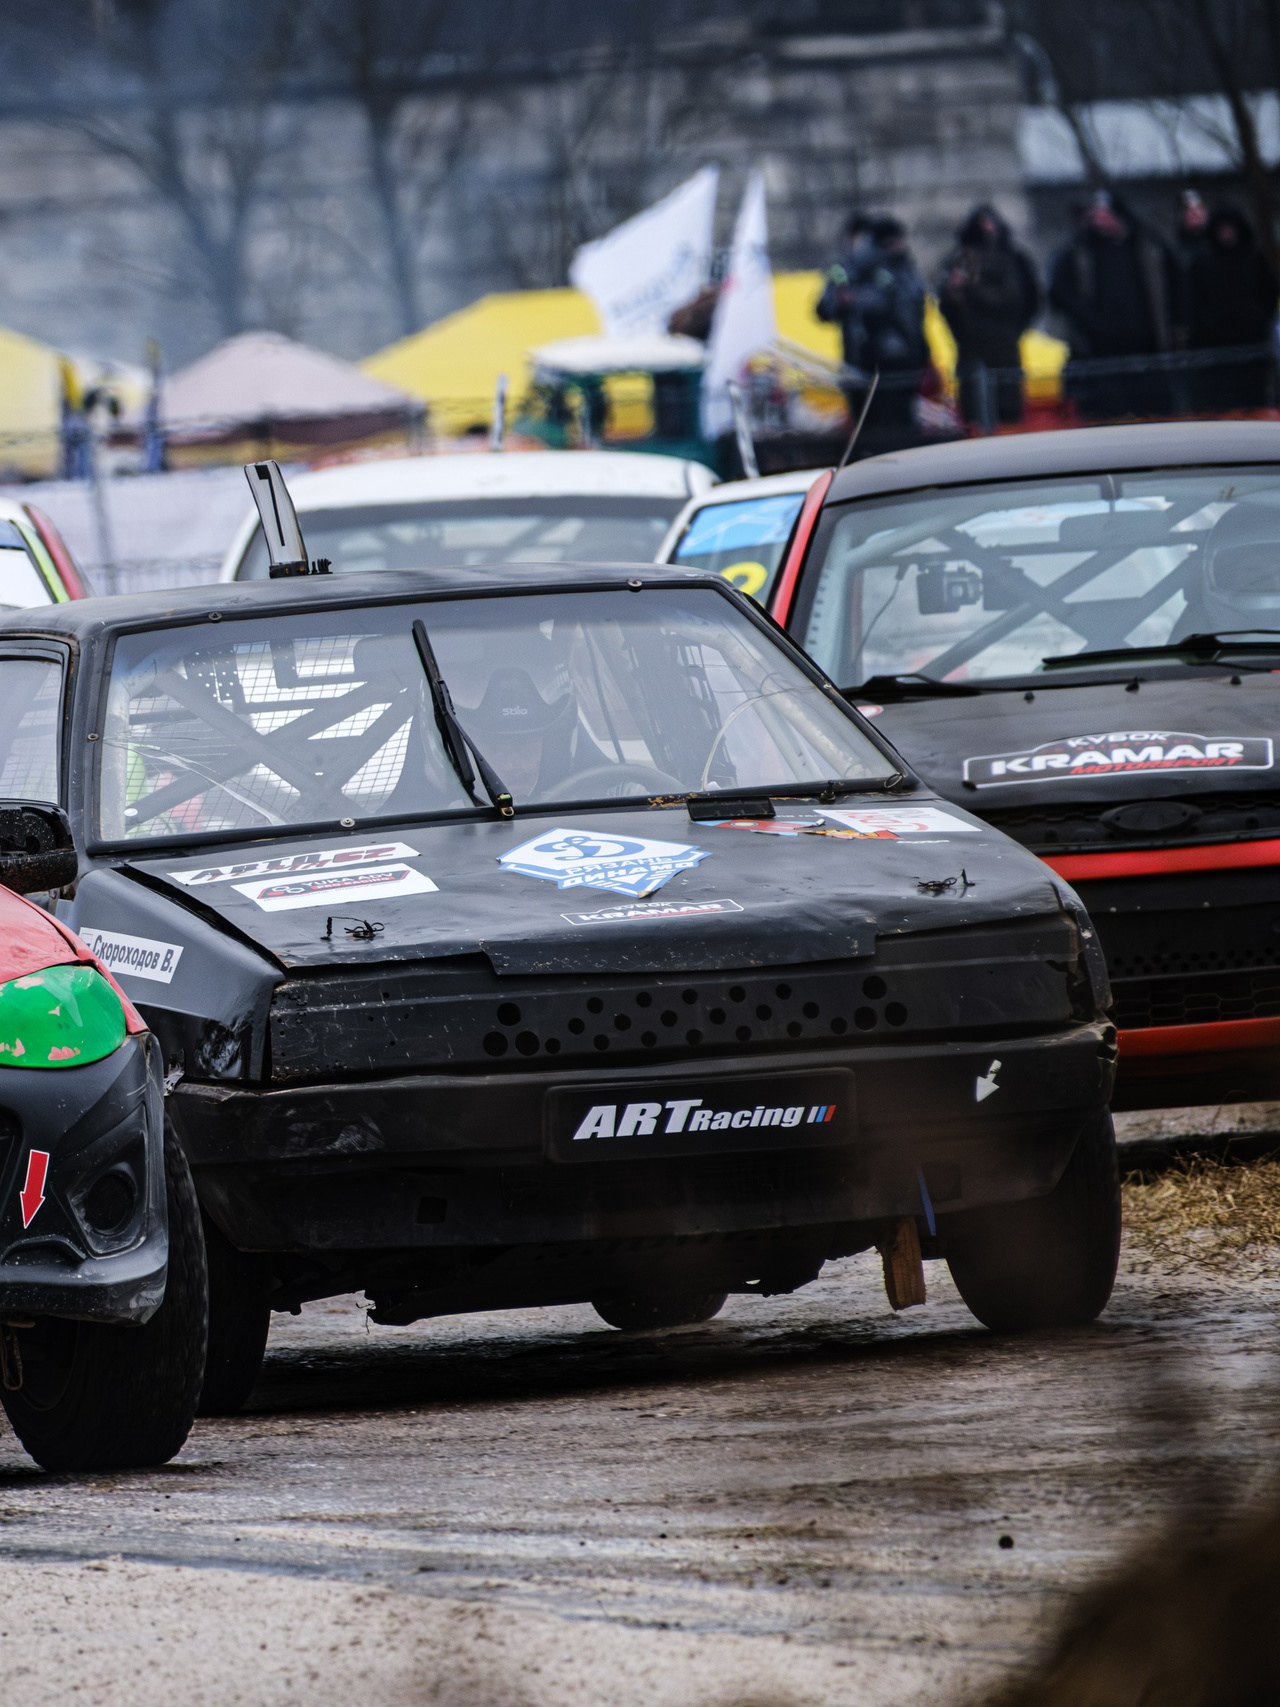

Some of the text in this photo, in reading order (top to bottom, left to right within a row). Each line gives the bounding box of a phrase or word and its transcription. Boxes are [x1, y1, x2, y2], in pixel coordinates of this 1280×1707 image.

[990, 741, 1245, 776] KRAMAR
[1069, 756, 1245, 775] MOTORSPORT
[562, 861, 695, 888] ДИНАМО
[564, 856, 673, 876] РЯЗАНЬ
[302, 872, 394, 887] YUKA ADV
[578, 903, 722, 921] KRAMAR
[93, 934, 175, 973] Скороходов В.
[573, 1099, 806, 1140] ART Racing
